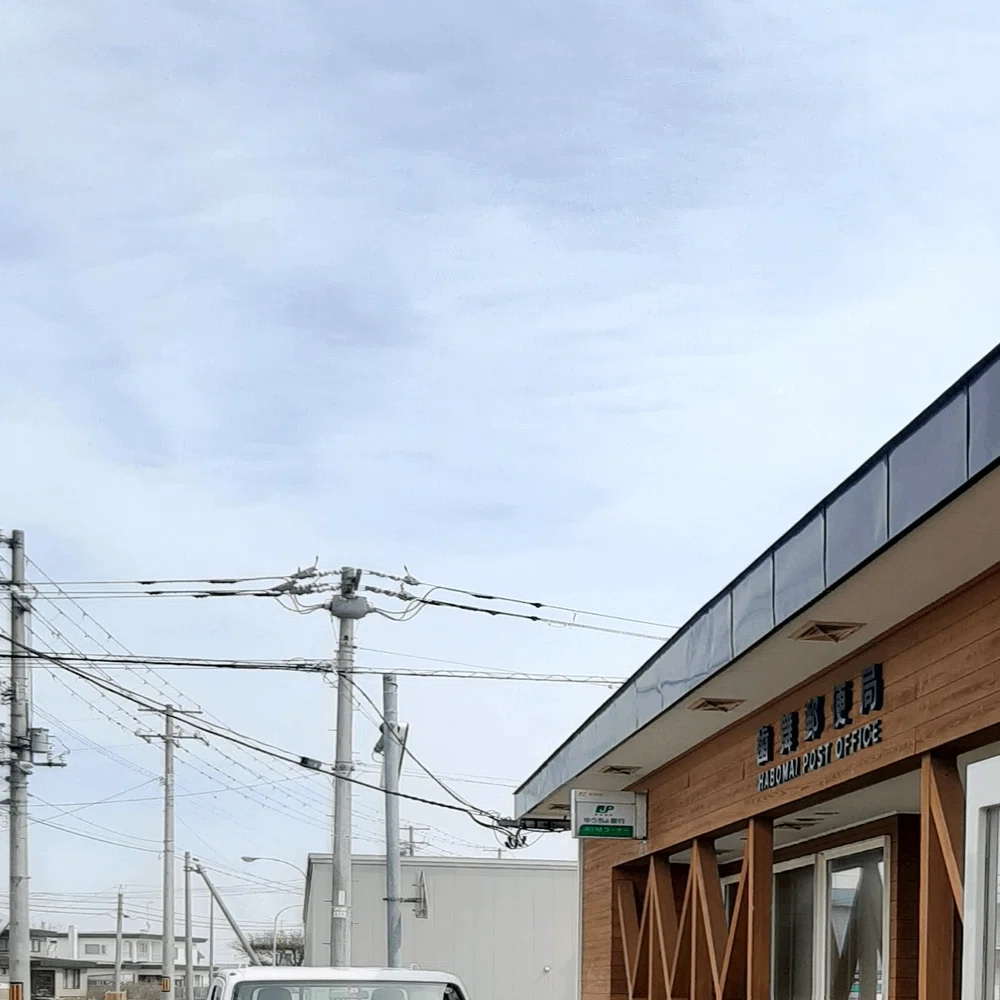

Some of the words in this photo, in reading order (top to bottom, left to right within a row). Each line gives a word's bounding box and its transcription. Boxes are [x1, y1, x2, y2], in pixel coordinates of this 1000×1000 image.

[757, 757, 801, 792] HABOMAI
[802, 742, 833, 775] POST
[834, 719, 883, 760] OFFICE
